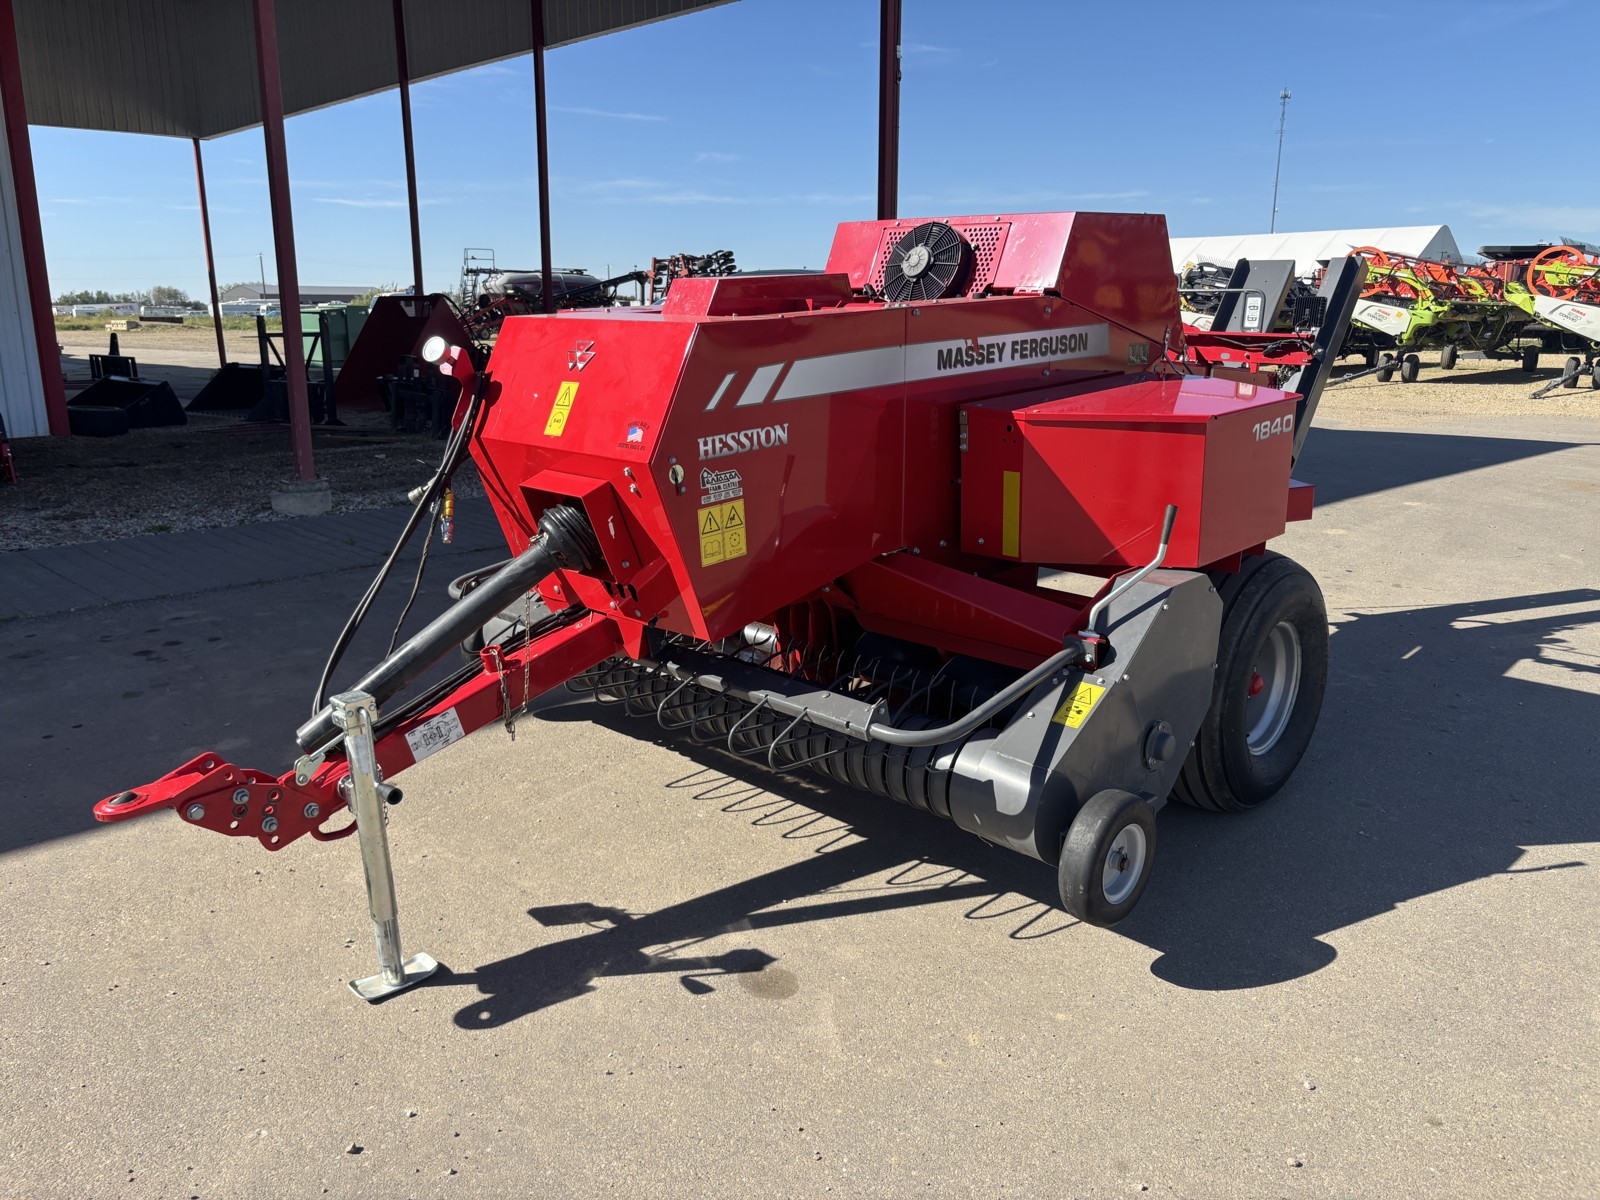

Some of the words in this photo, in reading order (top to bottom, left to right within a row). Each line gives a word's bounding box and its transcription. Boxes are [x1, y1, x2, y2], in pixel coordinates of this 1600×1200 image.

[937, 341, 1006, 371] MASSEY
[1010, 332, 1088, 361] FERGUSON
[697, 423, 788, 460] HESSTON
[1252, 413, 1294, 442] 1840
[701, 469, 741, 488] Pentagon
[729, 547, 743, 556] STOP
